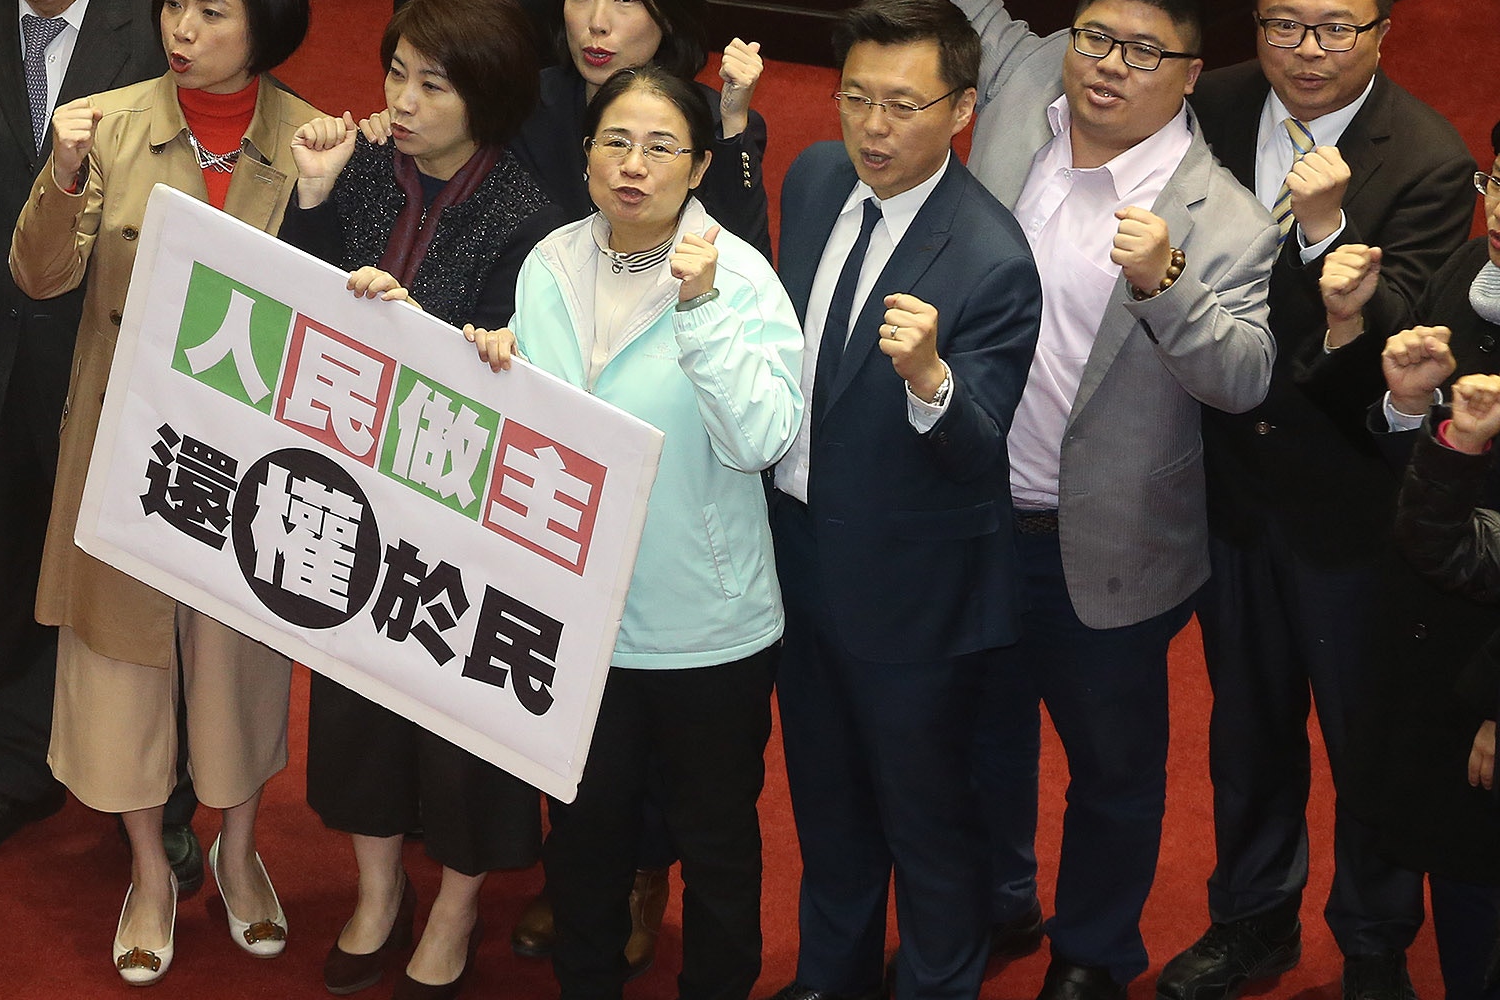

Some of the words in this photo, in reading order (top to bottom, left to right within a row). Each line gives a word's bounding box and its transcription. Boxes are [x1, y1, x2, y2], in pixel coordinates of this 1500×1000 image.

[138, 422, 565, 716] 還權於民
[183, 287, 599, 567] 人民做主
